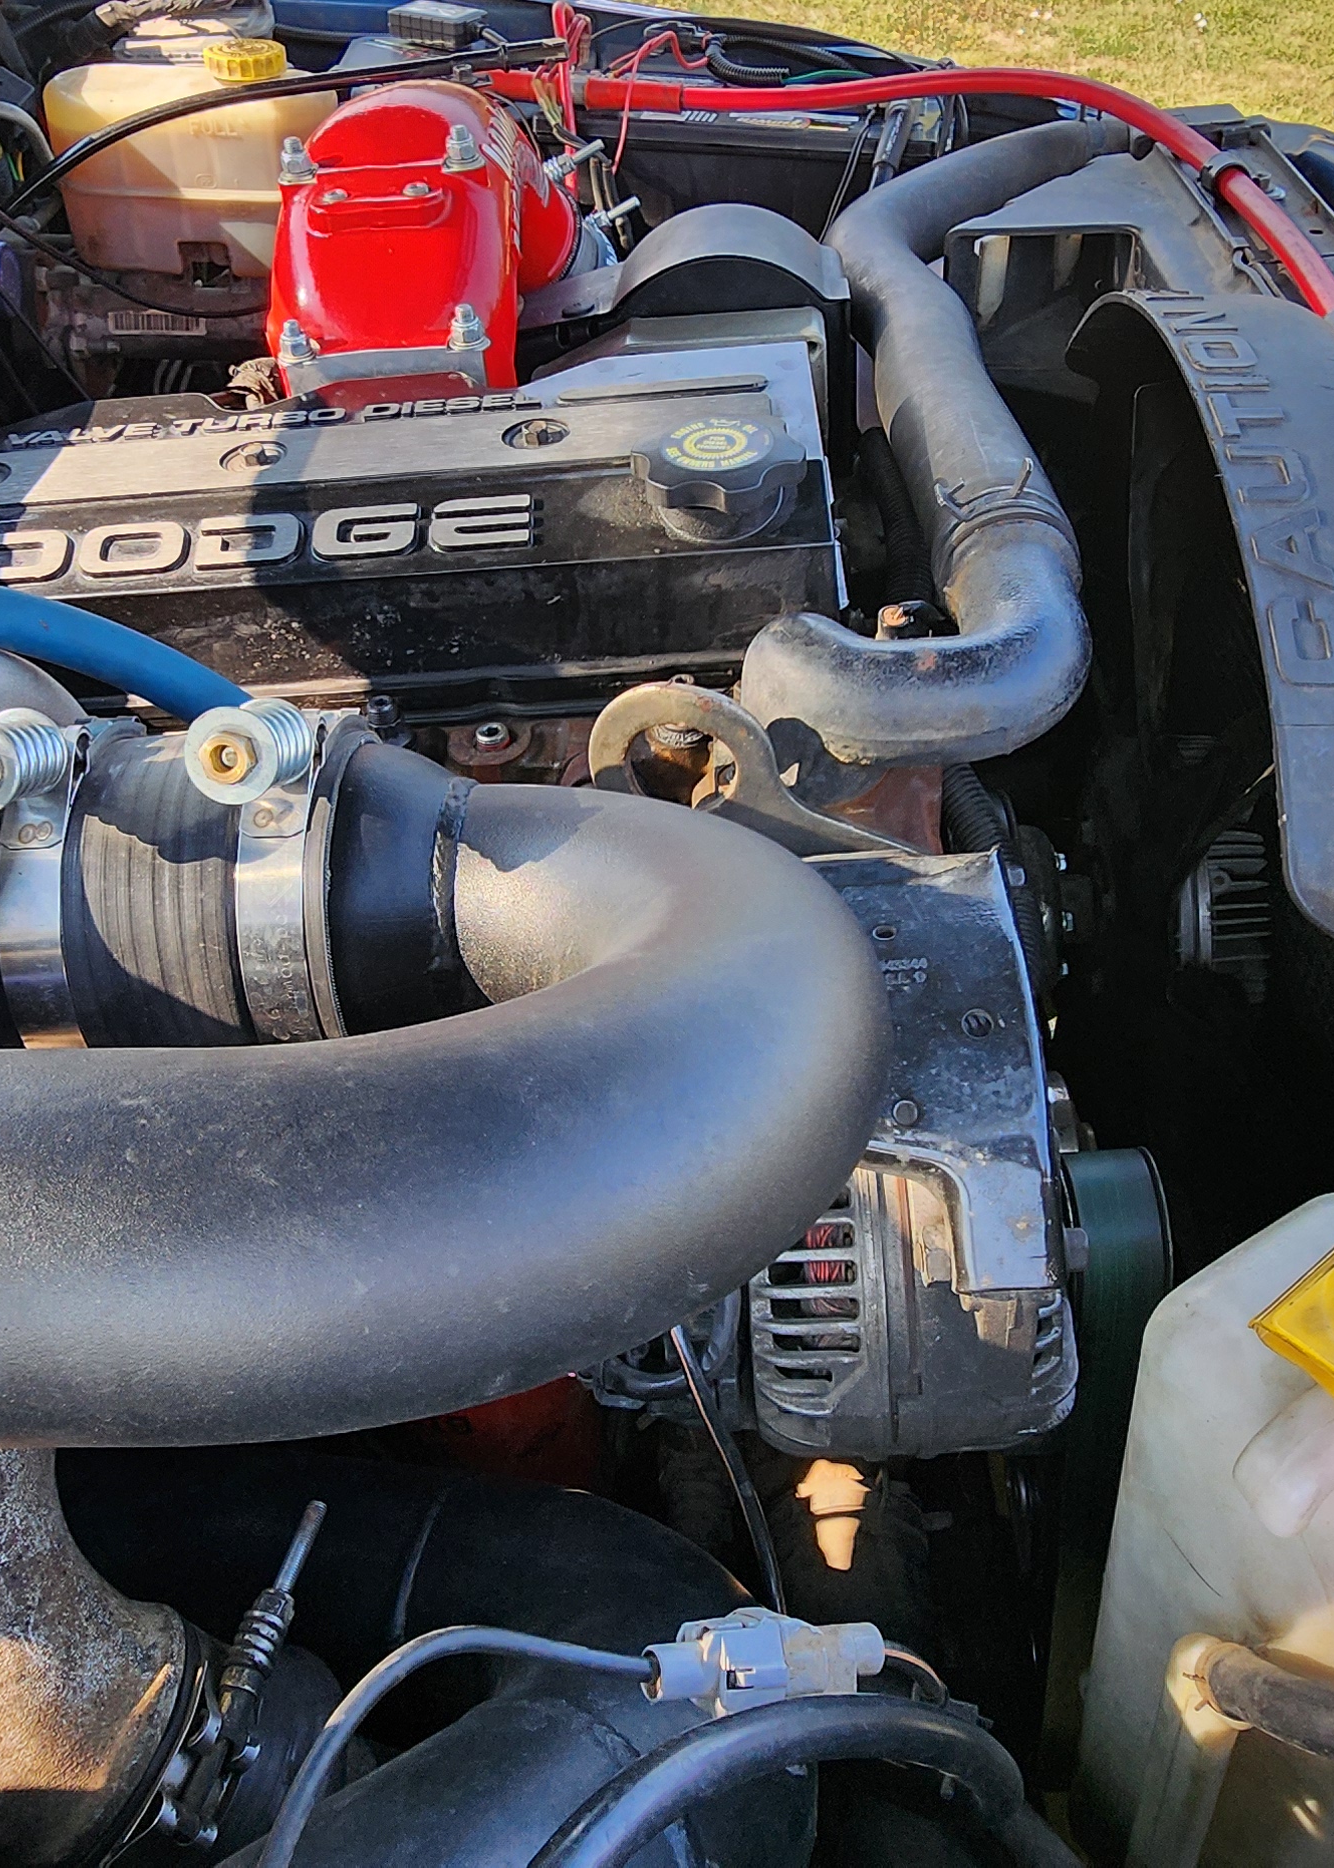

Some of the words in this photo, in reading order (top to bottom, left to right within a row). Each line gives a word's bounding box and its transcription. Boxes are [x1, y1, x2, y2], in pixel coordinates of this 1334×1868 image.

[189, 118, 238, 136] FULL
[5, 420, 161, 451] VALVE
[172, 406, 347, 437] TURBO
[360, 392, 546, 424] DIESEL
